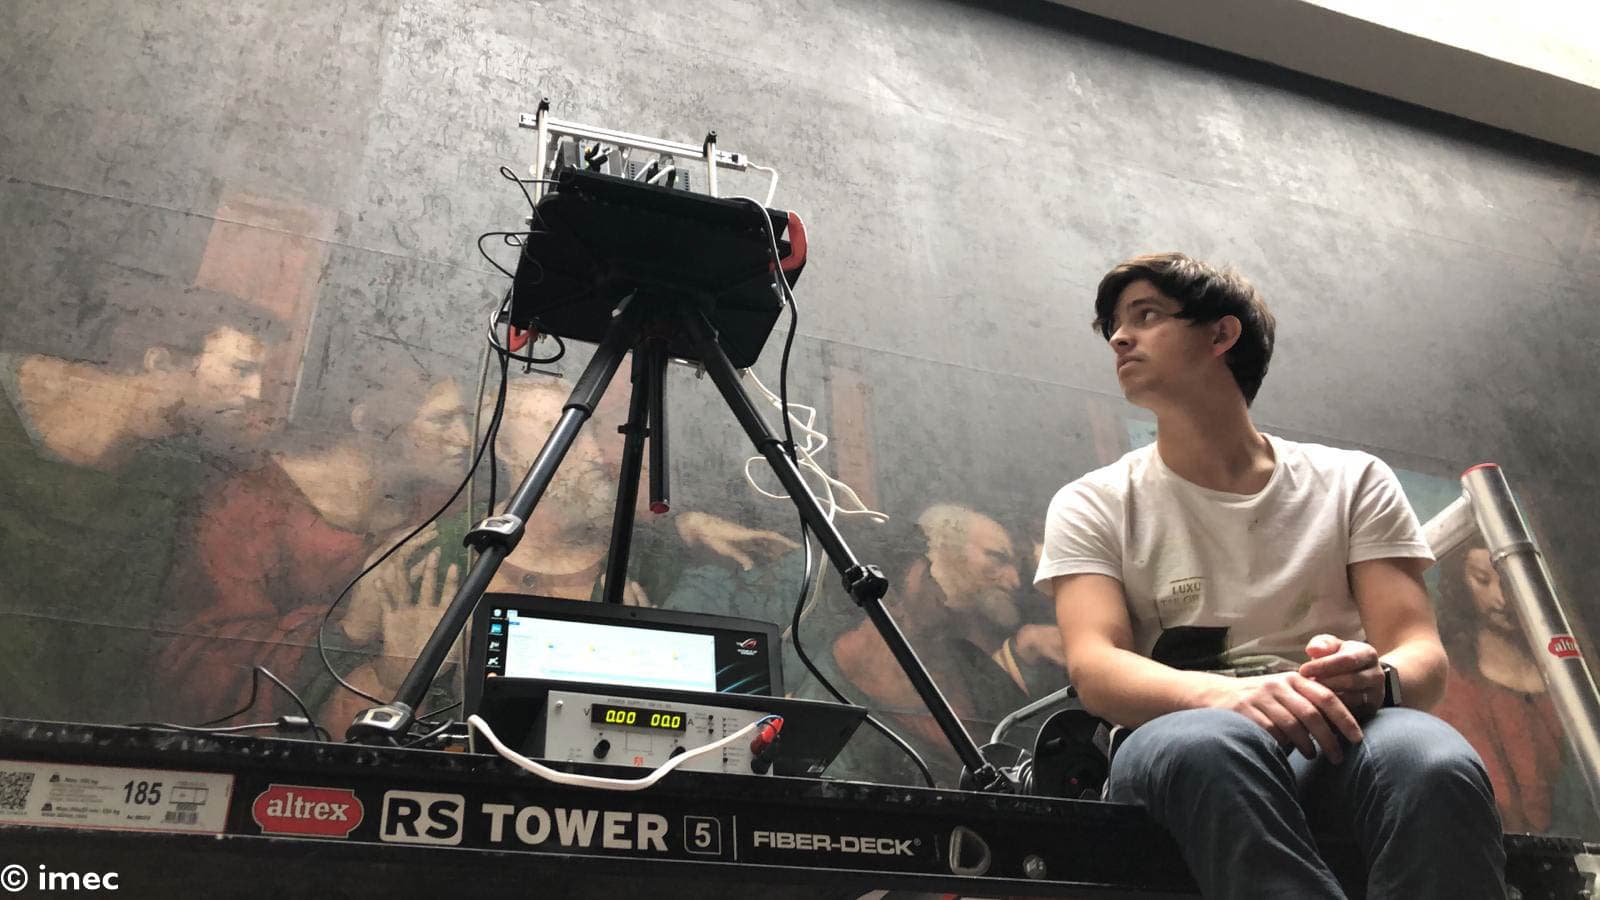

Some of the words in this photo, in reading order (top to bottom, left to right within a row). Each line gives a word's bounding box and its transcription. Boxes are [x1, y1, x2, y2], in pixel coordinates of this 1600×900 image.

[123, 780, 163, 806] 185
[267, 793, 349, 822] altrex
[384, 797, 460, 841] RS
[481, 802, 669, 852] TOWER
[694, 822, 711, 849] 5
